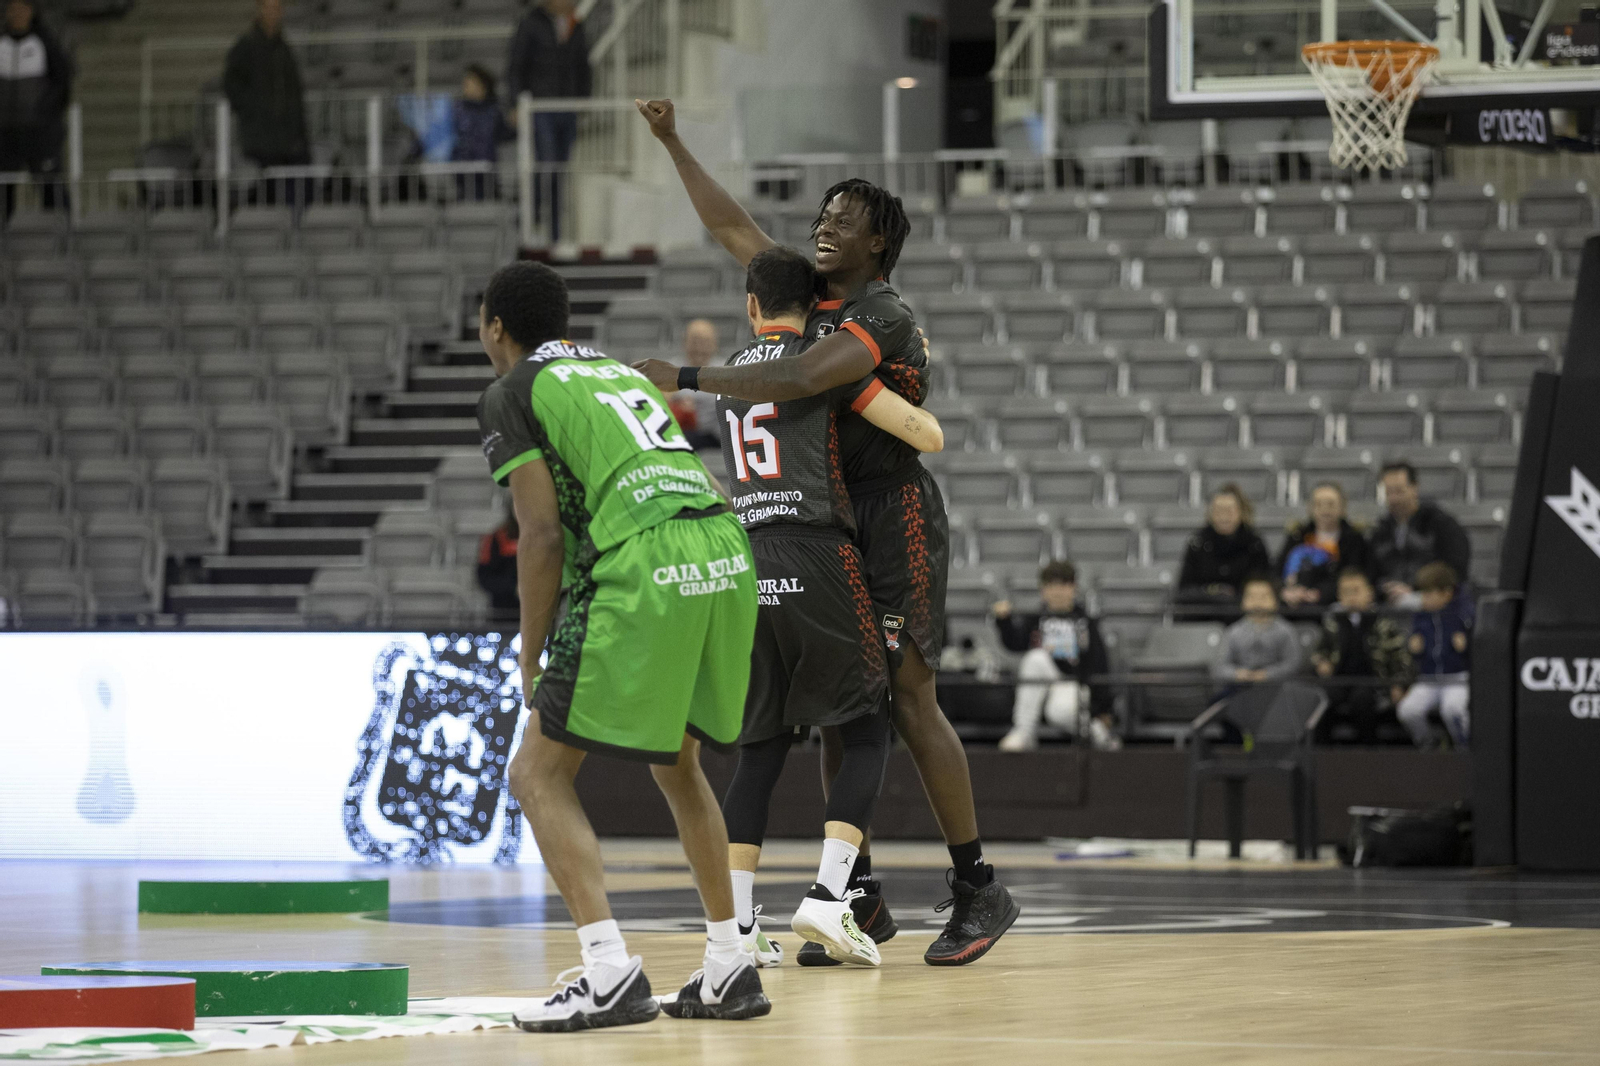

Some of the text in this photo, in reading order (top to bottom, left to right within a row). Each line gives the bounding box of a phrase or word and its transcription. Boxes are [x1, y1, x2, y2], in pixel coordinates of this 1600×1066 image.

[593, 388, 694, 453] 12
[725, 402, 781, 482] 15
[747, 504, 798, 523] GRANADA
[653, 563, 704, 585] CAJA
